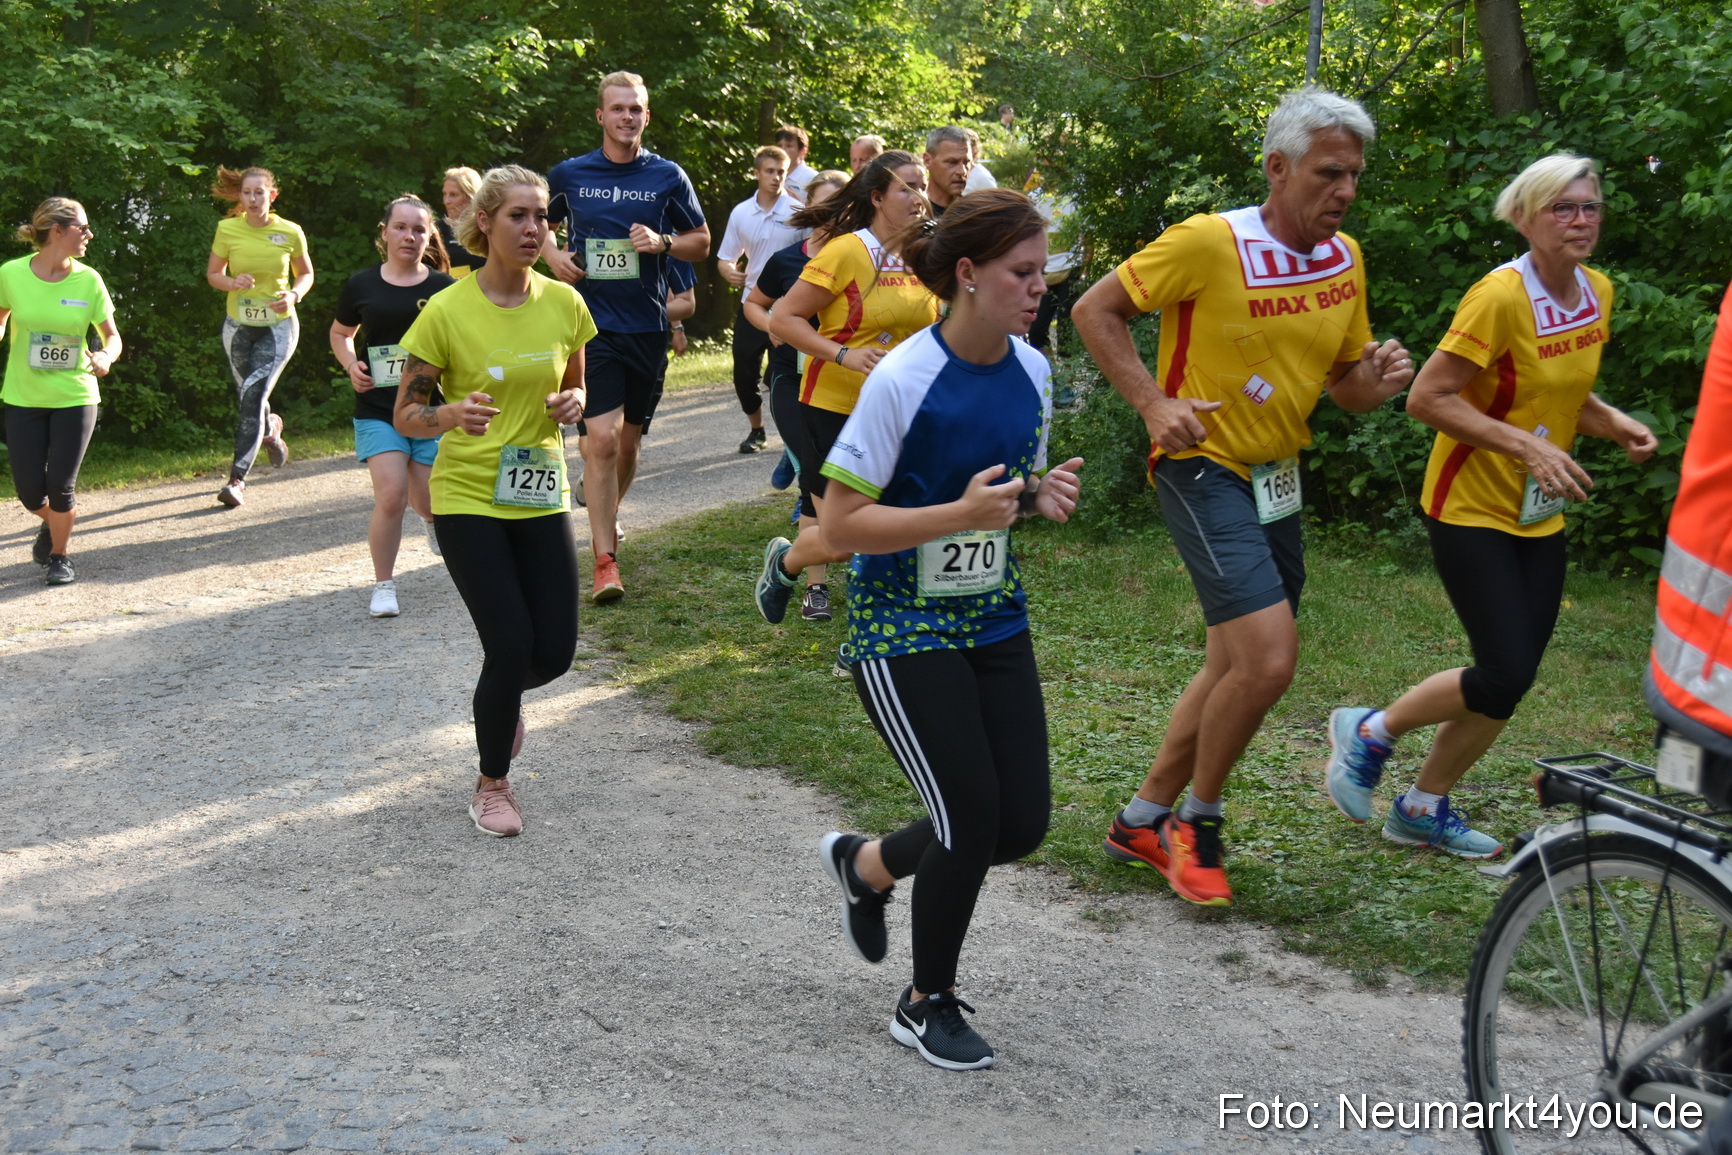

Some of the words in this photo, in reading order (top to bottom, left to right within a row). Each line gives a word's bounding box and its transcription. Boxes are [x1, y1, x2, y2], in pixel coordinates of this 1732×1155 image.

[579, 187, 611, 199] EURO
[622, 191, 657, 202] POLES
[596, 253, 627, 268] 703
[877, 276, 907, 287] MAX
[245, 307, 267, 319] 671
[1248, 294, 1311, 319] MAX
[40, 346, 70, 361] 666
[1537, 339, 1572, 360] MAX
[507, 467, 556, 491] 1275
[1263, 469, 1296, 502] 1668
[942, 540, 995, 573] 270
